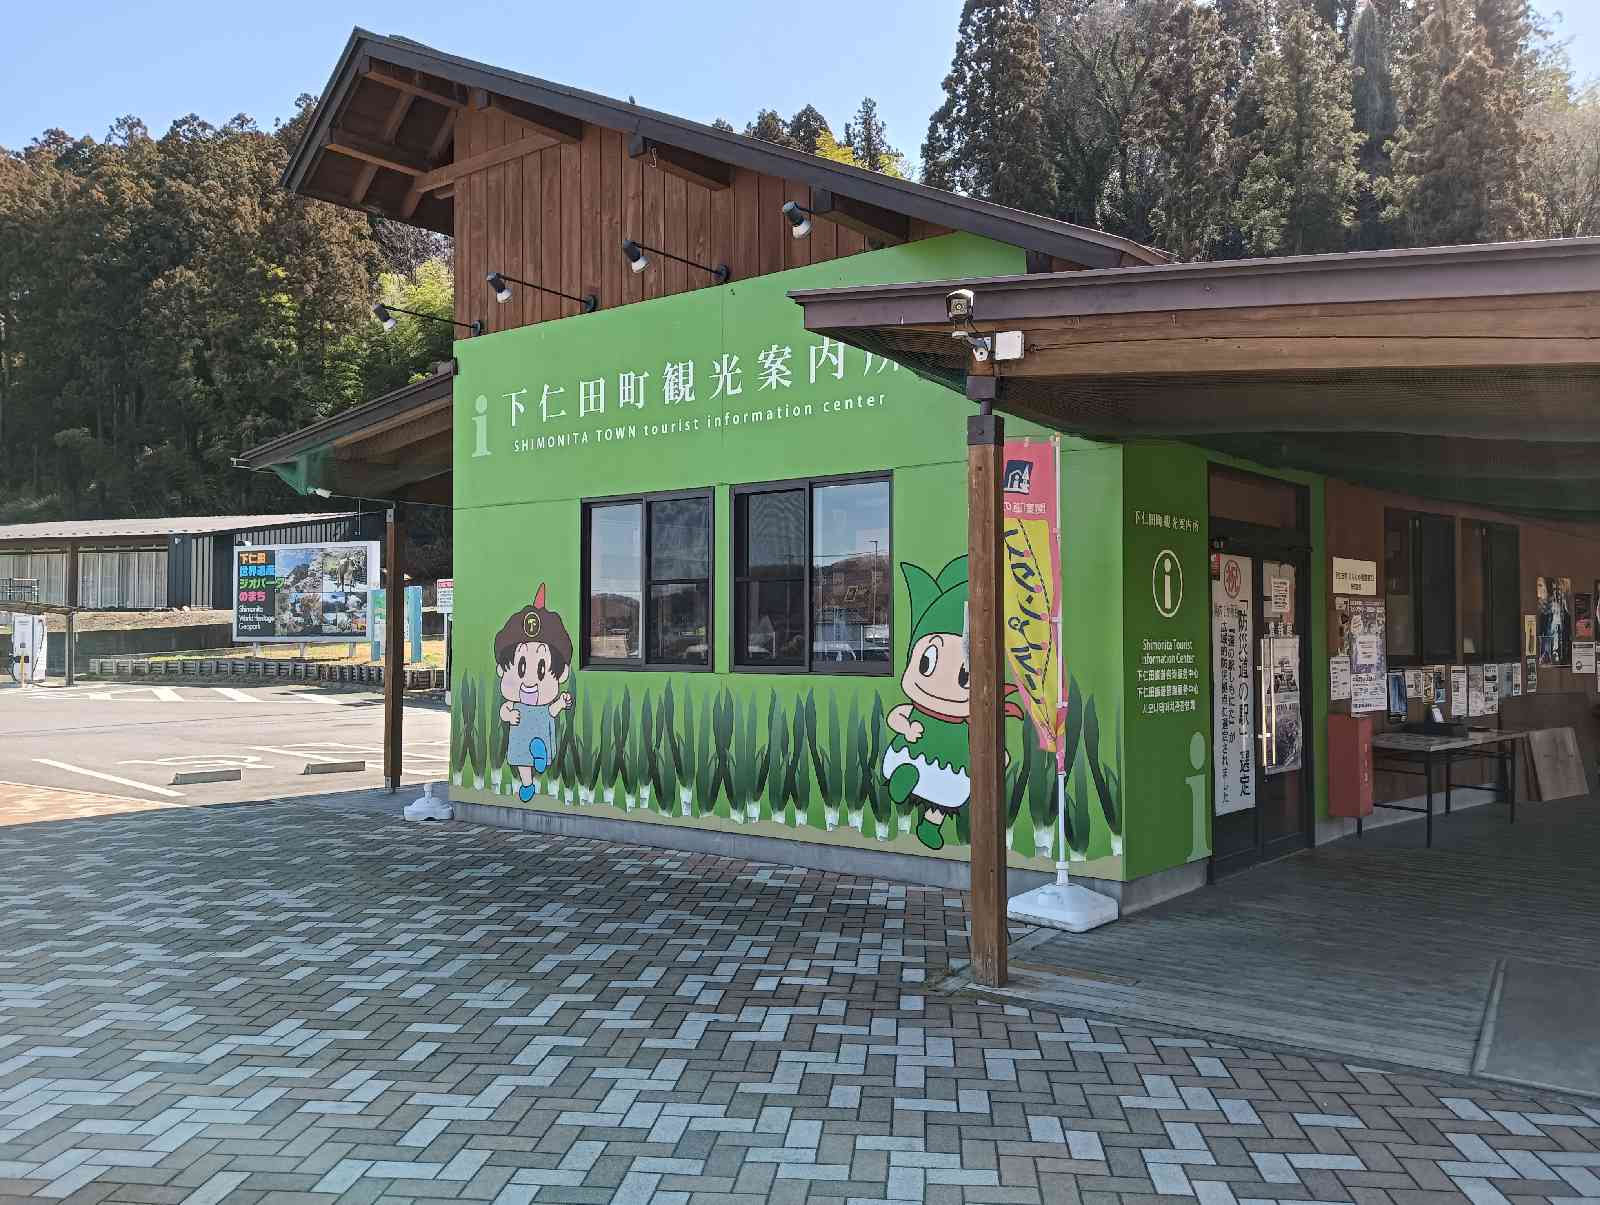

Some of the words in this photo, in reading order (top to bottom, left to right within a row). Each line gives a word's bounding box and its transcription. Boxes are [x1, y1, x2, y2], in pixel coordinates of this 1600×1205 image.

[513, 430, 590, 453] SHIMONITA
[595, 425, 637, 444] TOWN
[643, 417, 700, 437] tourist
[706, 401, 814, 430] information
[822, 391, 886, 413] center
[239, 591, 266, 602] のまち
